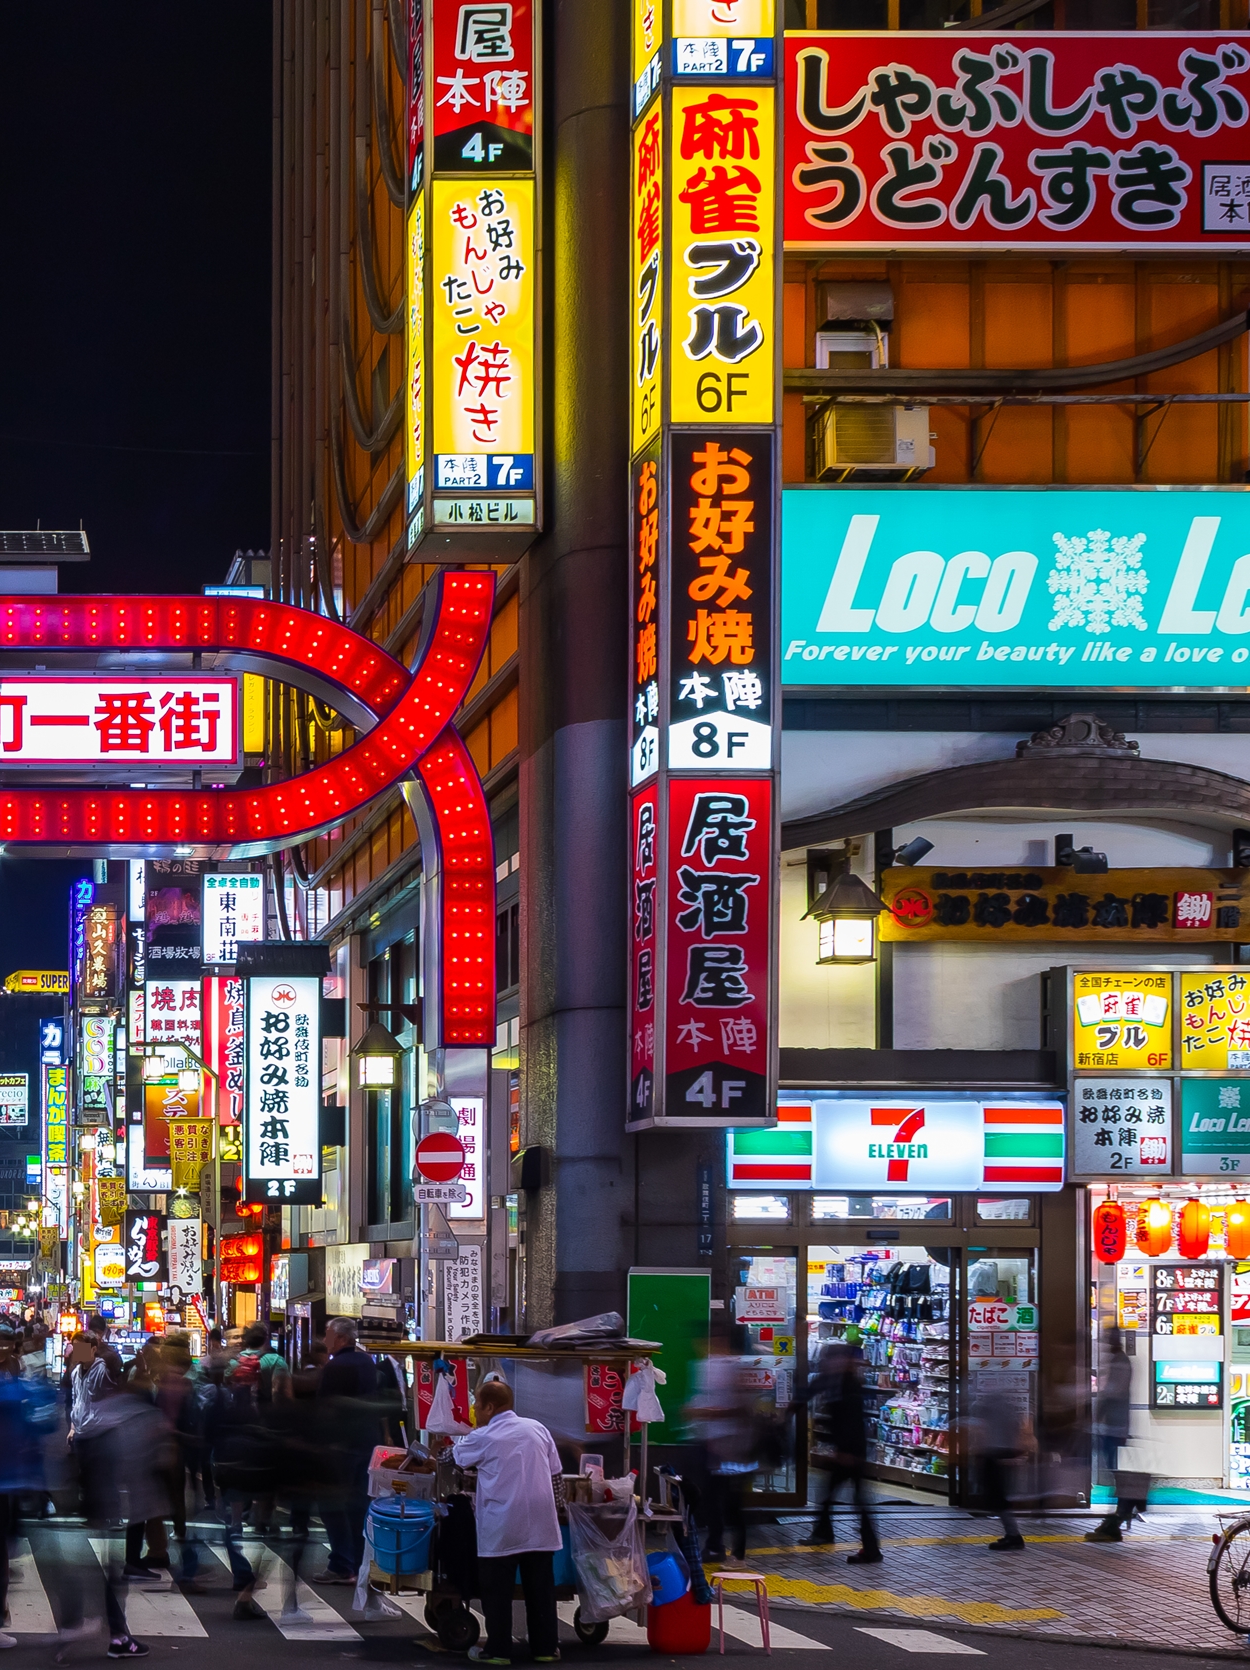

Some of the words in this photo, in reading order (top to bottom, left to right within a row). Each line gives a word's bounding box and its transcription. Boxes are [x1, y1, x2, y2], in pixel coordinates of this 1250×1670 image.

[454, 3, 515, 63] 屋
[683, 59, 724, 72] PART2
[731, 39, 767, 73] 7F
[436, 68, 529, 113] 本陣
[795, 42, 1250, 139] しゃぶしゃぶ
[461, 132, 504, 163] 4F
[792, 135, 1193, 231] うどんすき
[1217, 200, 1250, 224] 本
[678, 93, 764, 364] 麻雀ブル
[637, 111, 661, 388] 麻雀ブル
[451, 203, 506, 324] もんじゃ
[442, 275, 480, 335] たこ
[453, 340, 512, 444] 焼き
[696, 372, 751, 413] 6F
[444, 473, 482, 485] PART2
[492, 456, 524, 486] 7F
[448, 502, 519, 523] 小松ビル
[687, 441, 755, 667] お好み焼
[815, 514, 1039, 634] Loco
[783, 640, 897, 662] Forever
[905, 645, 970, 665] your
[976, 641, 1076, 665] beauty
[1081, 642, 1131, 662] like
[1140, 647, 1156, 662] a
[1164, 642, 1222, 663] love
[678, 670, 762, 711] 本陣
[691, 721, 749, 760] 8F
[206, 877, 260, 888] 全卓全自動
[675, 793, 759, 1010] 居酒屋
[218, 892, 238, 961] 東南荘
[40, 974, 69, 989] SUPER
[1080, 977, 1166, 988] 全国チェーンの店
[1184, 974, 1247, 1008] お好み
[1102, 993, 1141, 1016] 麻雀
[676, 1016, 758, 1056] 本陣
[1096, 1025, 1149, 1049] ブル
[1183, 1026, 1226, 1053] たこ
[1078, 1053, 1119, 1066] 新宿店
[1147, 1053, 1168, 1066] 6F
[259, 1011, 290, 1167] お好み焼本陣
[686, 1070, 747, 1109] 4F
[1082, 1087, 1163, 1100] 歌舞伎町名物
[48, 1068, 66, 1162] まんが喫茶
[1079, 1105, 1166, 1124] お好み焼
[1189, 1113, 1227, 1133] Loco
[174, 1124, 210, 1136] 悪質な
[1094, 1128, 1138, 1147] 本陣
[174, 1138, 210, 1149] 客引き
[870, 1106, 926, 1182] 7
[174, 1151, 210, 1163] に注意
[1110, 1152, 1134, 1170] 2F
[1219, 1157, 1240, 1172] 3F
[267, 1179, 297, 1198] 2F
[418, 1188, 463, 1200] 自転車を除く
[102, 1265, 125, 1276] 190円
[1156, 1269, 1174, 1288] 8F
[459, 1255, 472, 1337] 防犯カメラ作動
[747, 1289, 775, 1300] ATM
[1155, 1292, 1174, 1311] 7F
[969, 1307, 1009, 1324] たばこ
[1016, 1307, 1034, 1325] 酒
[1156, 1315, 1174, 1335] 6F
[1156, 1385, 1174, 1404] 2F
